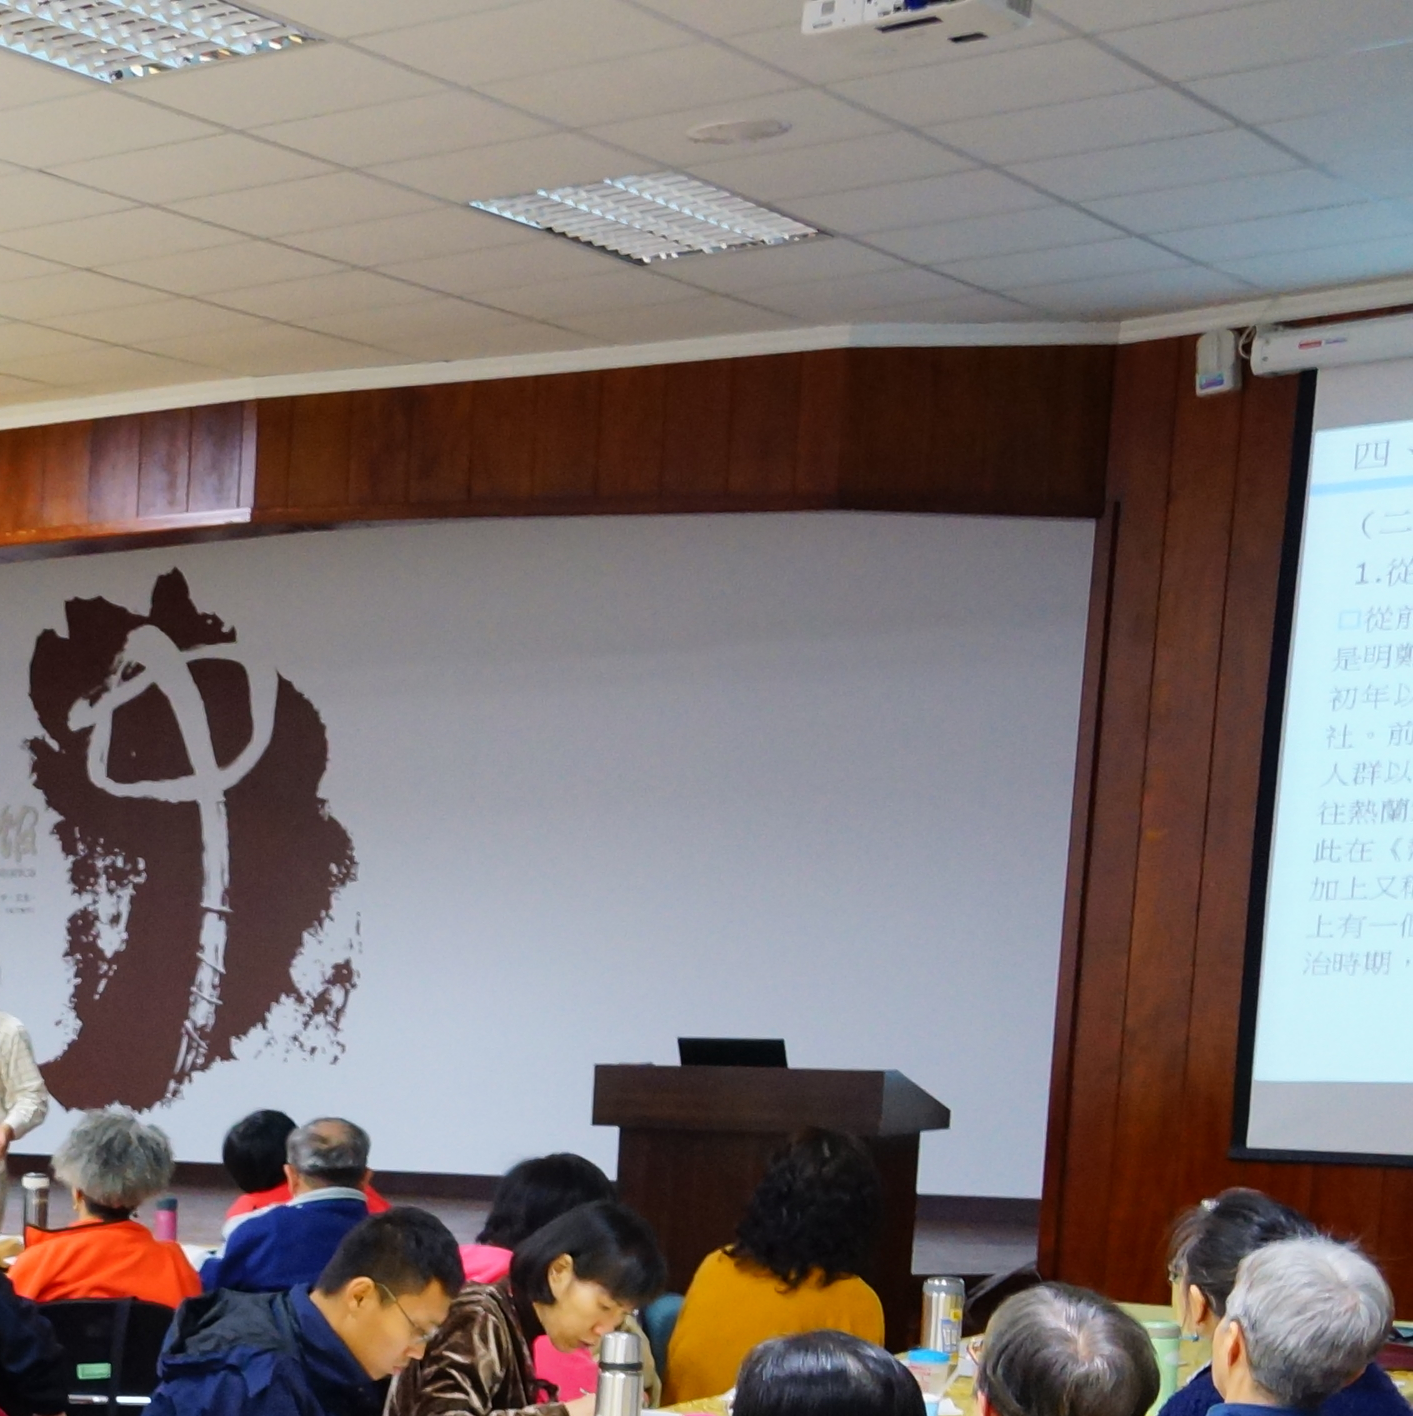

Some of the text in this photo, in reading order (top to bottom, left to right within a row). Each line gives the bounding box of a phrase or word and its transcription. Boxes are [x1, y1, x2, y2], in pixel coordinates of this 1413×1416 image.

[1321, 760, 1412, 788] 人群以
[1316, 798, 1413, 826] 往熱蘭
[1312, 837, 1413, 864] 此在《
